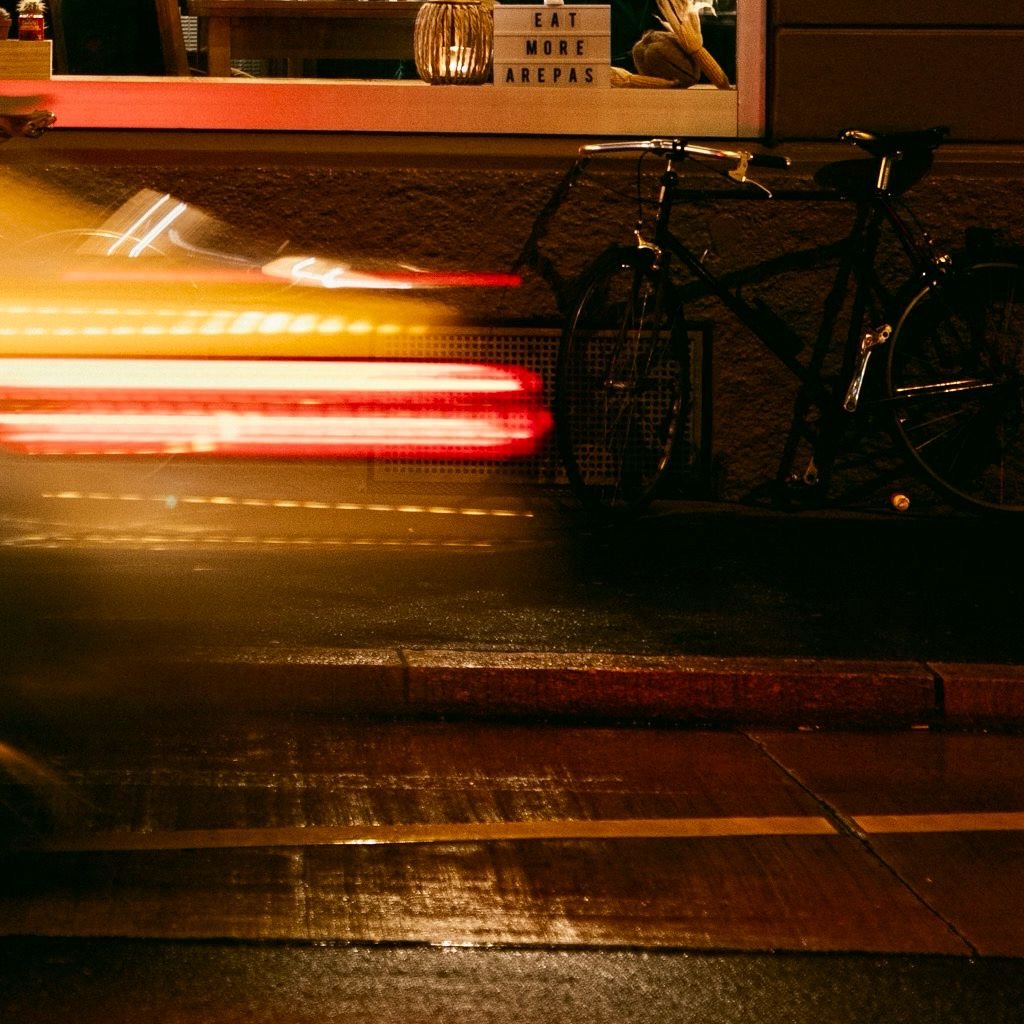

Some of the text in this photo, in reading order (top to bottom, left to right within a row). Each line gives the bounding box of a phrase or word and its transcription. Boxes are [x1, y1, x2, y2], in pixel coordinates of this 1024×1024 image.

[534, 11, 578, 28] EAT
[526, 39, 585, 56] MORE
[506, 67, 594, 83] AREPAS
